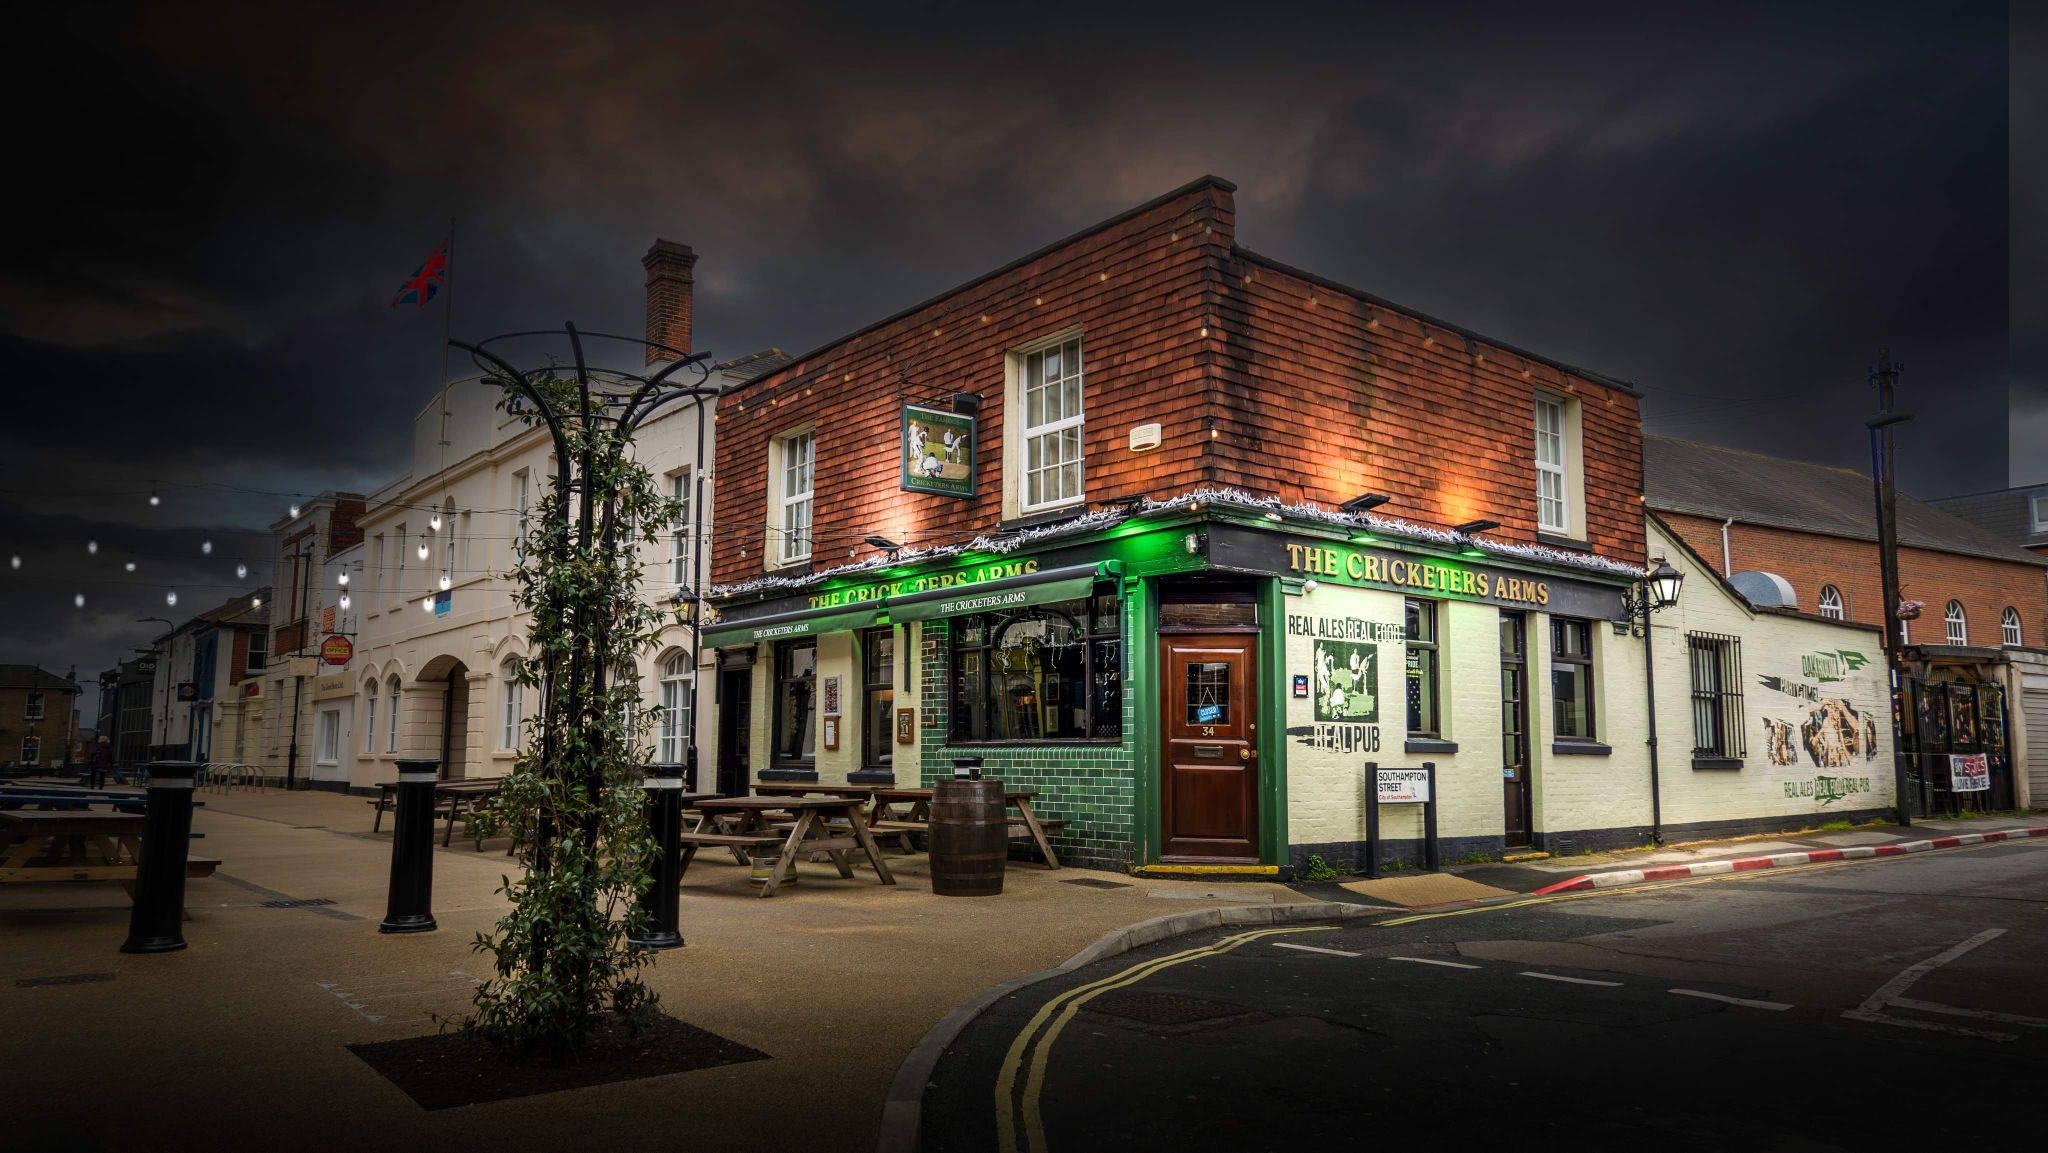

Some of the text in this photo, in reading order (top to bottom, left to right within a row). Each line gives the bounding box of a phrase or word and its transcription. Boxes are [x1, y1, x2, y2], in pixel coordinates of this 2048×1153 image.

[911, 477, 968, 493] CRICKETERS ARMS
[1286, 543, 1549, 605] THE CRICKETERS ARMS
[808, 591, 840, 609] THE
[976, 559, 1039, 584] ARMS
[940, 591, 1026, 613] THE CRICKETERS ARMS
[753, 623, 809, 639] THE CRICKETERS ARMS
[1288, 614, 1316, 637] REAL
[1318, 617, 1344, 639] ALES
[1345, 619, 1374, 641] REAL
[1202, 726, 1215, 736] 34
[1314, 724, 1380, 753] REAL PUB
[1378, 771, 1427, 782] SOUTHAMPTON
[1378, 782, 1402, 792] STREET
[1784, 782, 1799, 799] REAL
[1799, 781, 1814, 798] ALES
